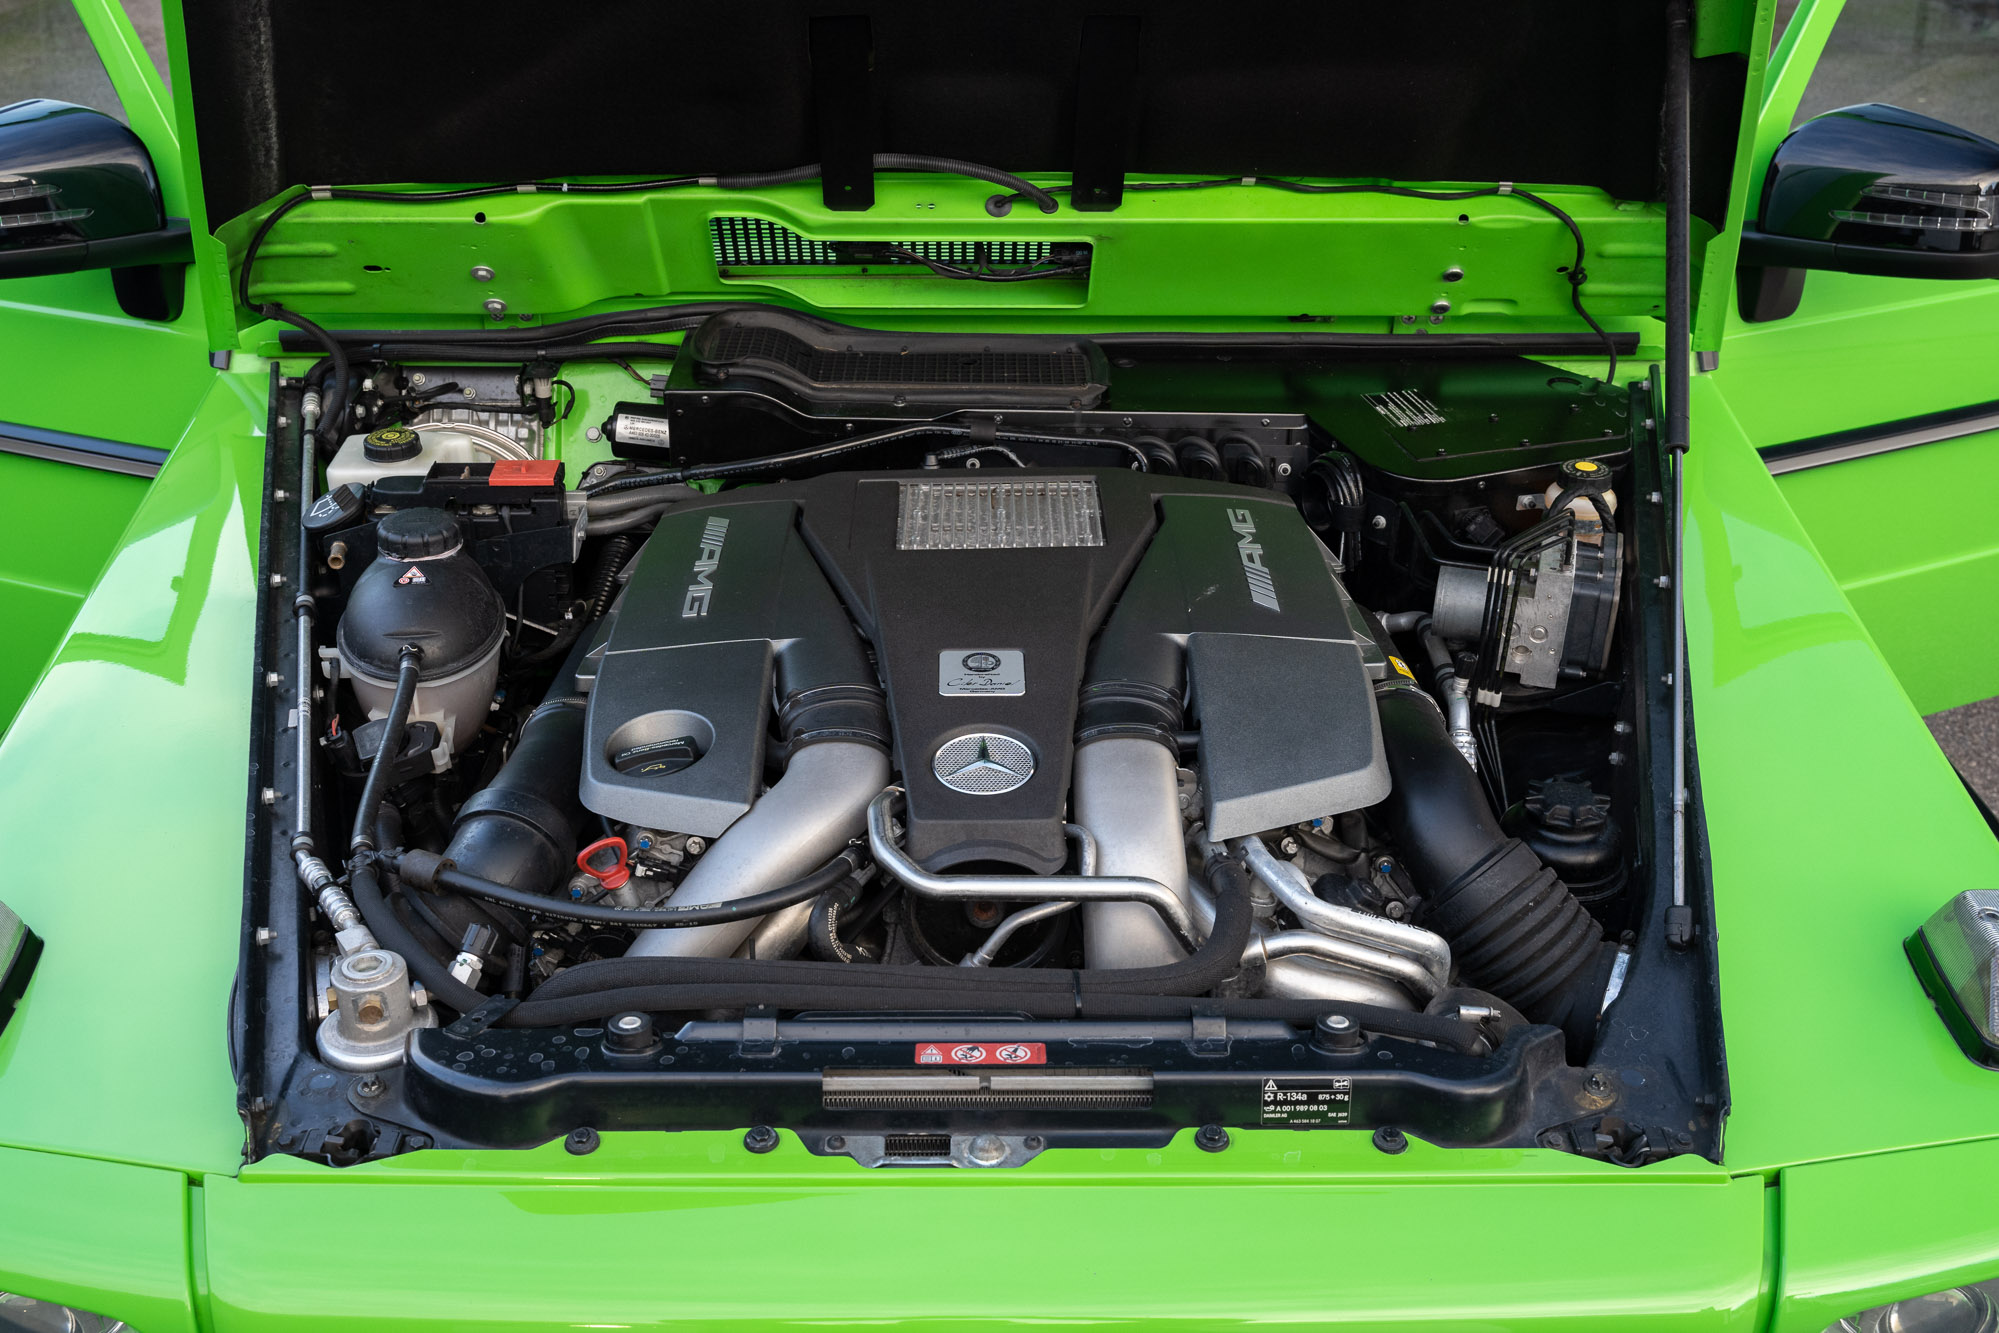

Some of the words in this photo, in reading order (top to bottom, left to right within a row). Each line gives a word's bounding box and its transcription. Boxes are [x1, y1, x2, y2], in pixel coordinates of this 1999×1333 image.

[1226, 508, 1270, 575] AMG
[682, 542, 722, 617] AMG
[1276, 1092, 1308, 1101] R-134a
